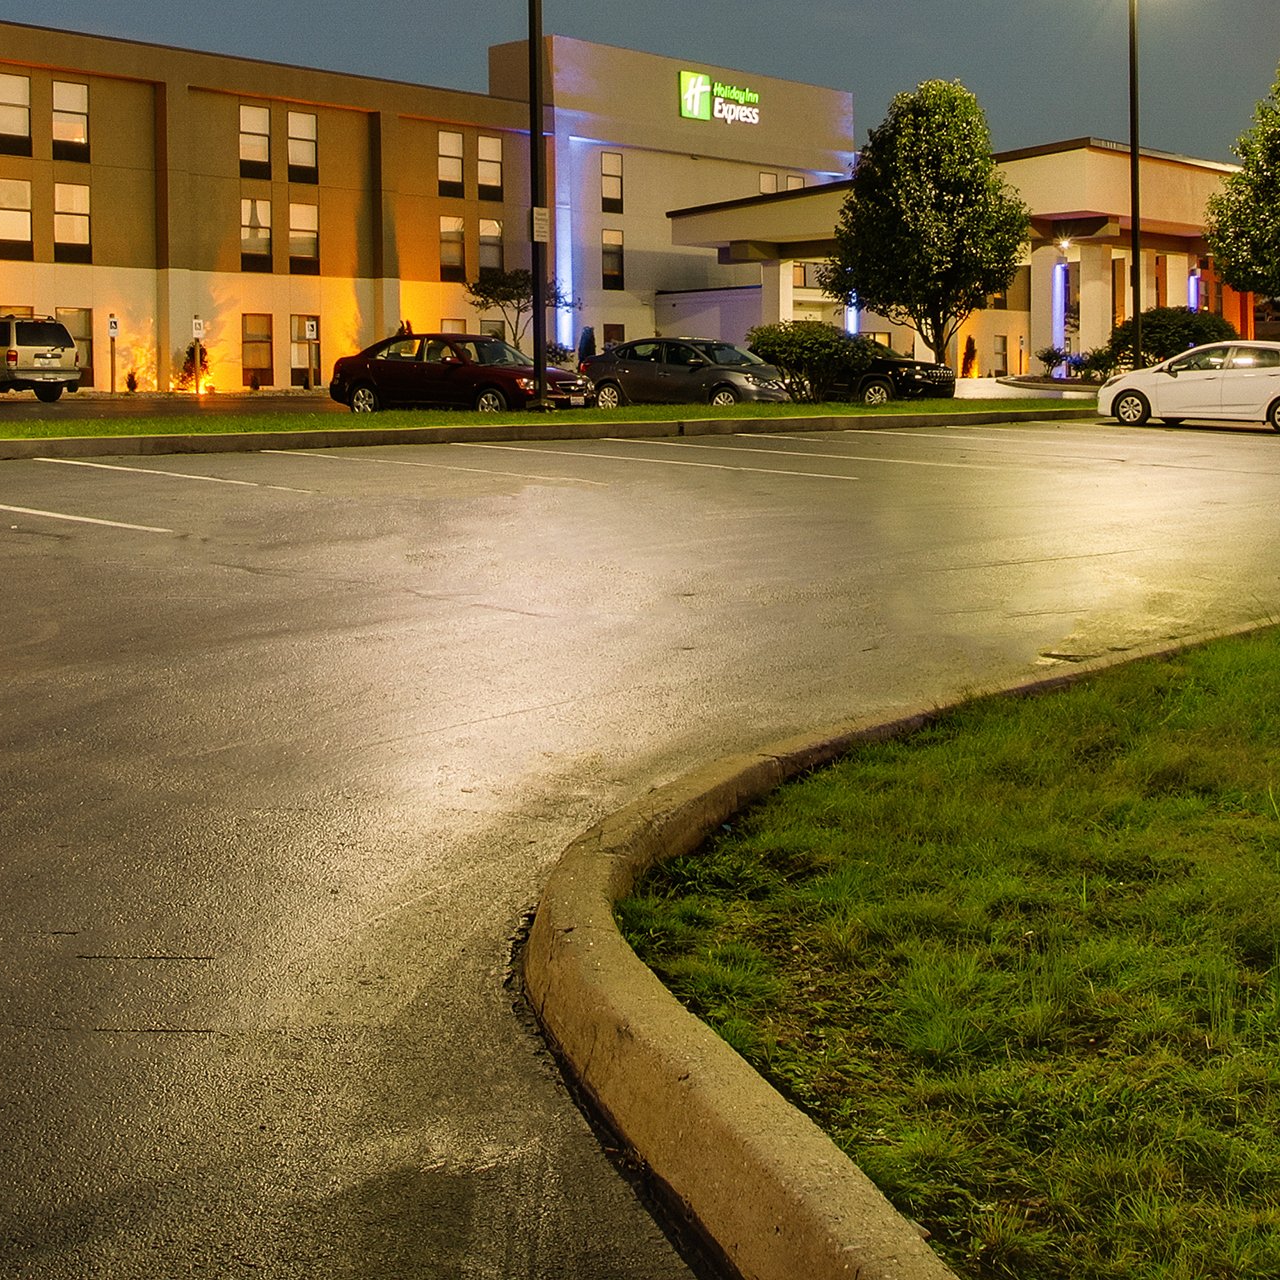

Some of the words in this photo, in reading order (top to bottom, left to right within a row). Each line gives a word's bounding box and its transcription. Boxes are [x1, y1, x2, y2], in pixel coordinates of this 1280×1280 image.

[713, 82, 745, 104] Holiday
[745, 87, 759, 103] Inn
[713, 97, 760, 124] Express
